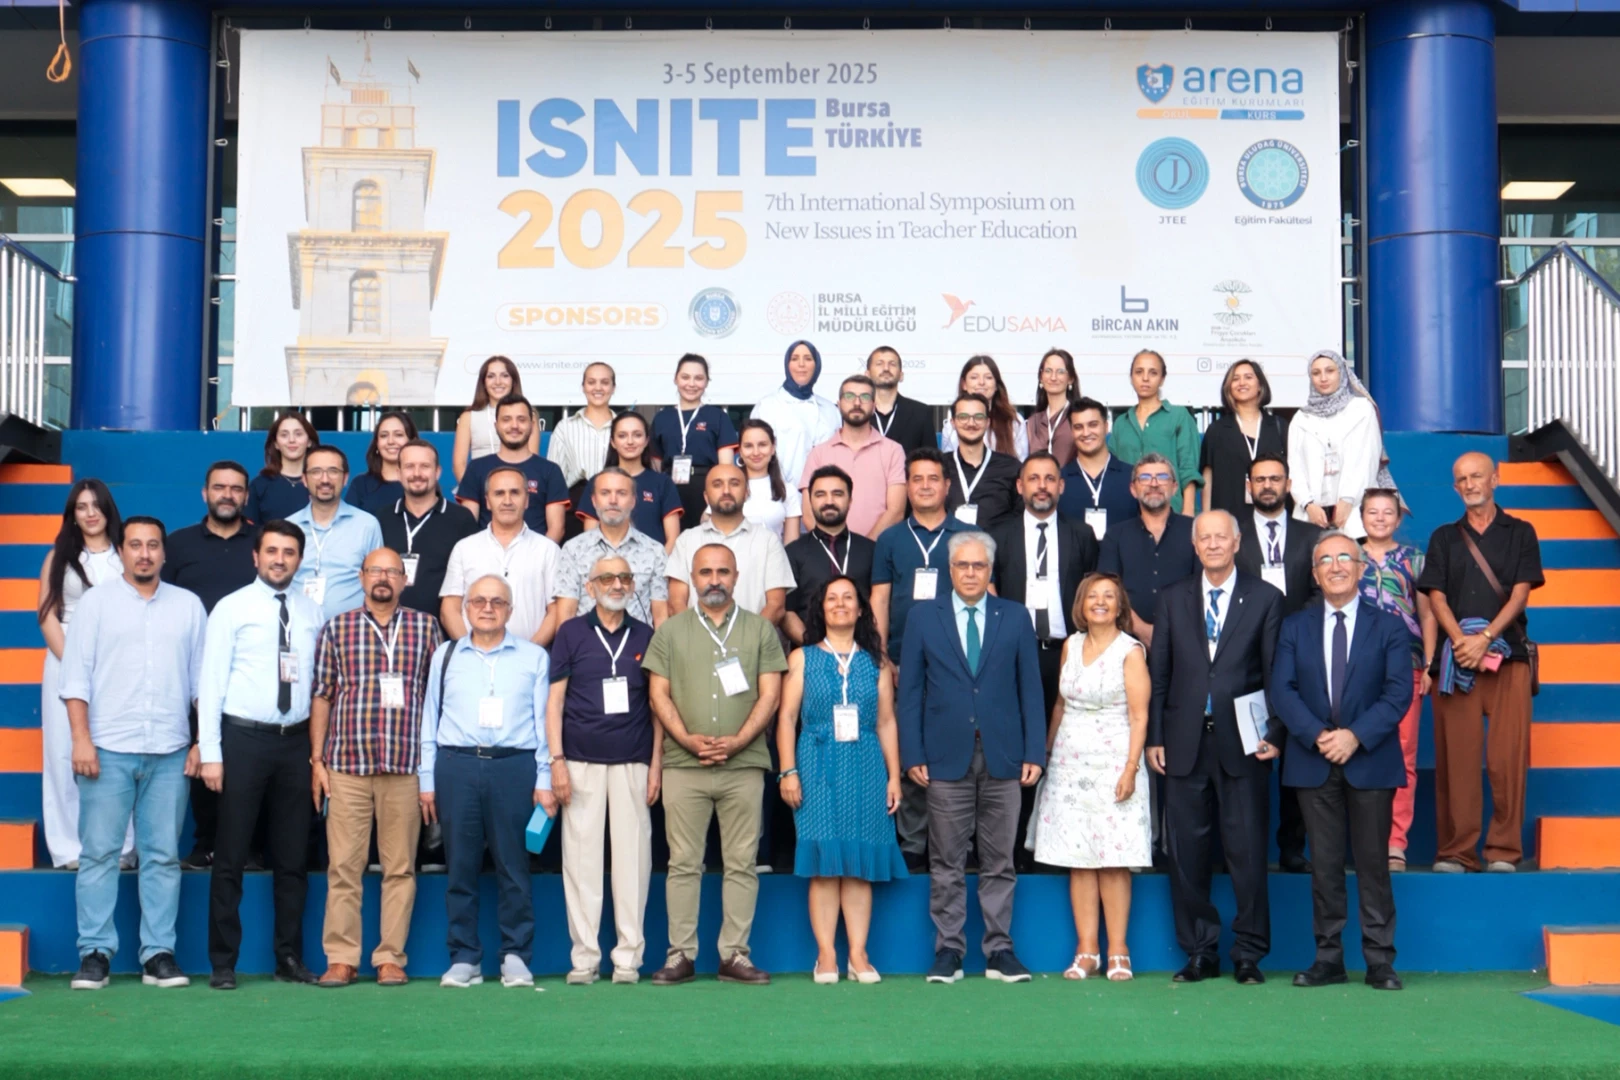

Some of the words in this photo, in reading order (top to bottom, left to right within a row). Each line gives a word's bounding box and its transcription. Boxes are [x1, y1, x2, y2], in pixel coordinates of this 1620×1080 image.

[662, 63, 696, 84] 3-5
[703, 62, 820, 89] September
[826, 63, 878, 84] 2025
[1182, 66, 1304, 94] arena
[825, 98, 891, 118] Bursa
[1232, 97, 1305, 107] KURUMLARI
[1247, 111, 1277, 120] KURS
[497, 97, 817, 178] ISNITE
[825, 121, 922, 148] TÜRKİYE
[1238, 159, 1248, 188] BURSA
[1244, 140, 1276, 160] ULUDAĞ
[765, 192, 794, 211] 7th
[800, 192, 925, 211] International
[930, 191, 1045, 215] Symposium
[1050, 196, 1075, 210] on
[497, 187, 747, 269] 2025
[765, 221, 809, 239] New
[814, 221, 872, 239] Issues
[876, 220, 895, 239] in
[898, 220, 977, 239] Teacher
[981, 219, 1078, 239] Education
[1158, 215, 1187, 225] JTEE
[1235, 215, 1267, 227] Eğitim
[1269, 215, 1313, 225] Fakültesi
[818, 292, 862, 303] BURSA
[509, 306, 660, 326] SPONSORS
[818, 304, 830, 316] İL
[872, 304, 916, 316] EĞİTİM
[818, 317, 916, 332] MÜDÜRLÜĞÜ
[963, 315, 1068, 333] EDUSAMA
[1092, 315, 1142, 331] BİRCAN
[1146, 318, 1179, 331] AKIN
